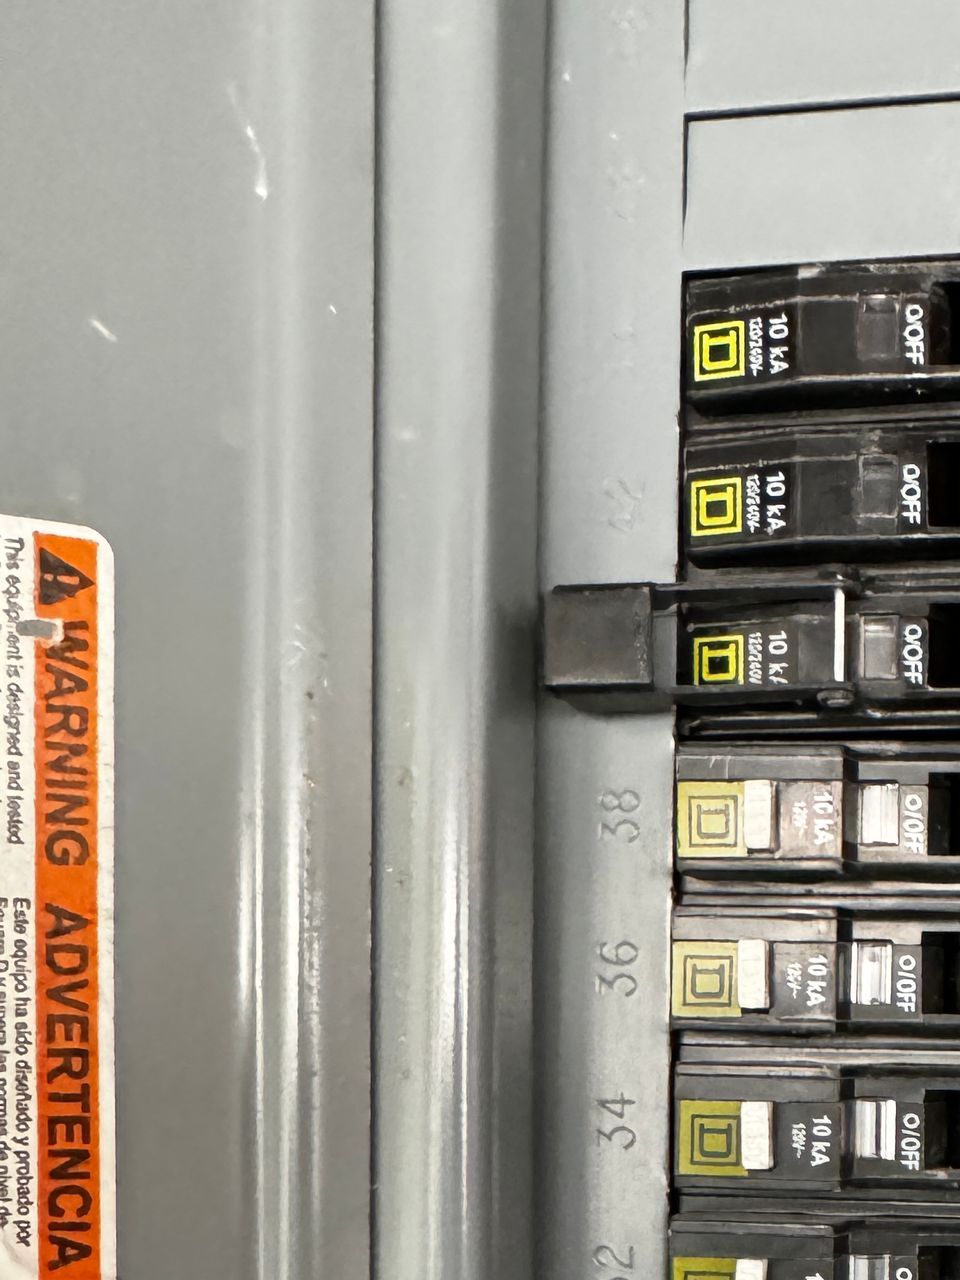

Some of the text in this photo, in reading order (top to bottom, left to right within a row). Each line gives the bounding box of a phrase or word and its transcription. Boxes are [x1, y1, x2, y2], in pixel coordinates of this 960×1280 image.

[768, 313, 790, 374] 10 kA
[765, 472, 786, 532] 10 kA
[5, 538, 24, 570] This
[768, 631, 787, 655] 10
[45, 620, 90, 865] WARNING
[7, 761, 24, 790] and
[600, 789, 640, 844] 38
[13, 898, 31, 934] Este
[9, 939, 32, 992] equipo
[598, 940, 639, 996] 36
[806, 954, 827, 1007] 10 kA
[15, 998, 32, 1017] ha
[15, 1022, 32, 1055] sido
[46, 903, 92, 1271] ADVERTENCIA
[11, 1137, 31, 1146] y
[597, 1092, 635, 1150] 34
[810, 1115, 832, 1167] 10 kA
[14, 1151, 33, 1215] probado
[13, 1221, 33, 1247] por
